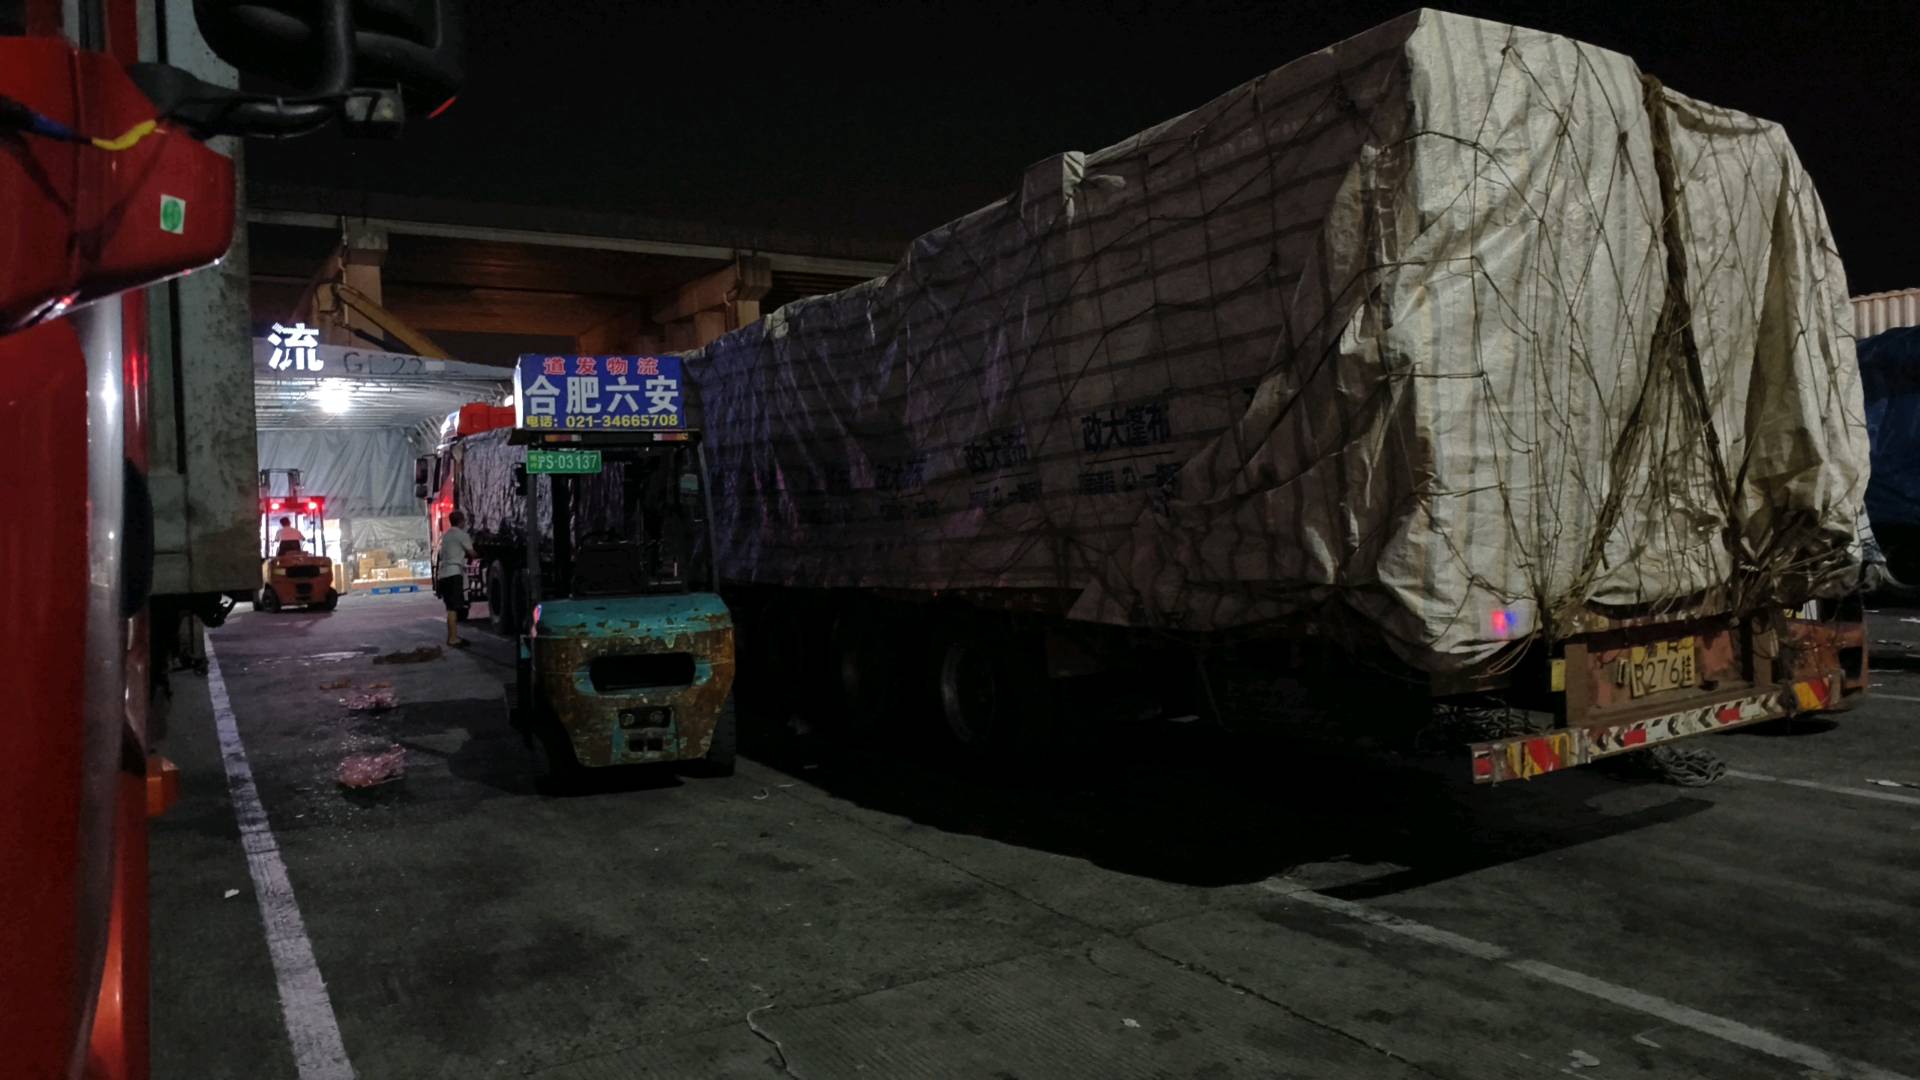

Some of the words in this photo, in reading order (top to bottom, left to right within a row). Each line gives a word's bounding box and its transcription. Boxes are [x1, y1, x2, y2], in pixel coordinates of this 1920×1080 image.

[267, 322, 324, 371] 流
[544, 357, 659, 375] 道发物流
[525, 375, 678, 414] 合肥六安
